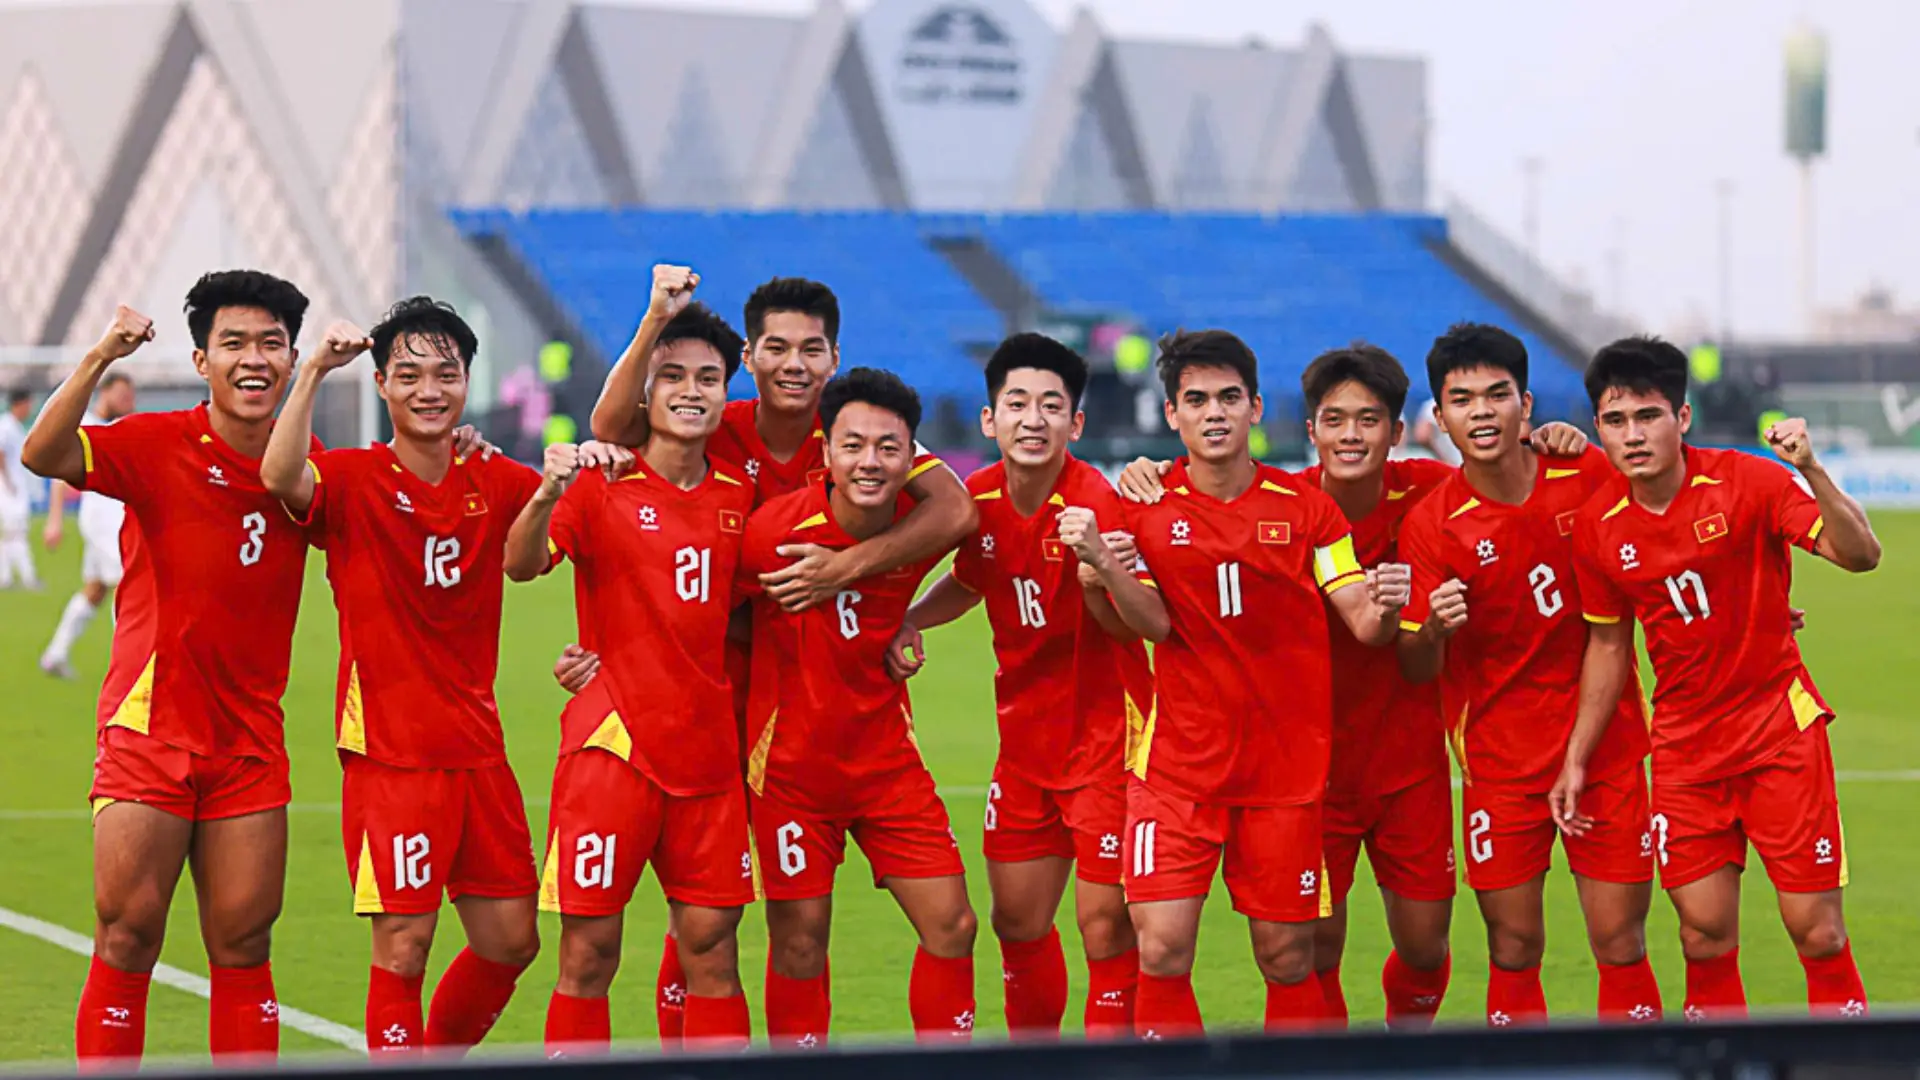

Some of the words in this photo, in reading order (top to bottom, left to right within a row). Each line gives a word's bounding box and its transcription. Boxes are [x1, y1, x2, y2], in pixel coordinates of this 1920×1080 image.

[239, 511, 267, 566] 3
[424, 535, 461, 588] 12
[675, 545, 711, 603] 21
[1217, 561, 1243, 618] 11
[1528, 563, 1564, 618] 2
[1664, 569, 1711, 625] 17
[836, 590, 863, 640] 6
[1012, 576, 1047, 629] 16
[393, 832, 431, 891] 12
[574, 832, 617, 889] 21
[776, 820, 807, 877] 6
[1133, 821, 1157, 877] 11
[1470, 809, 1494, 864] 2
